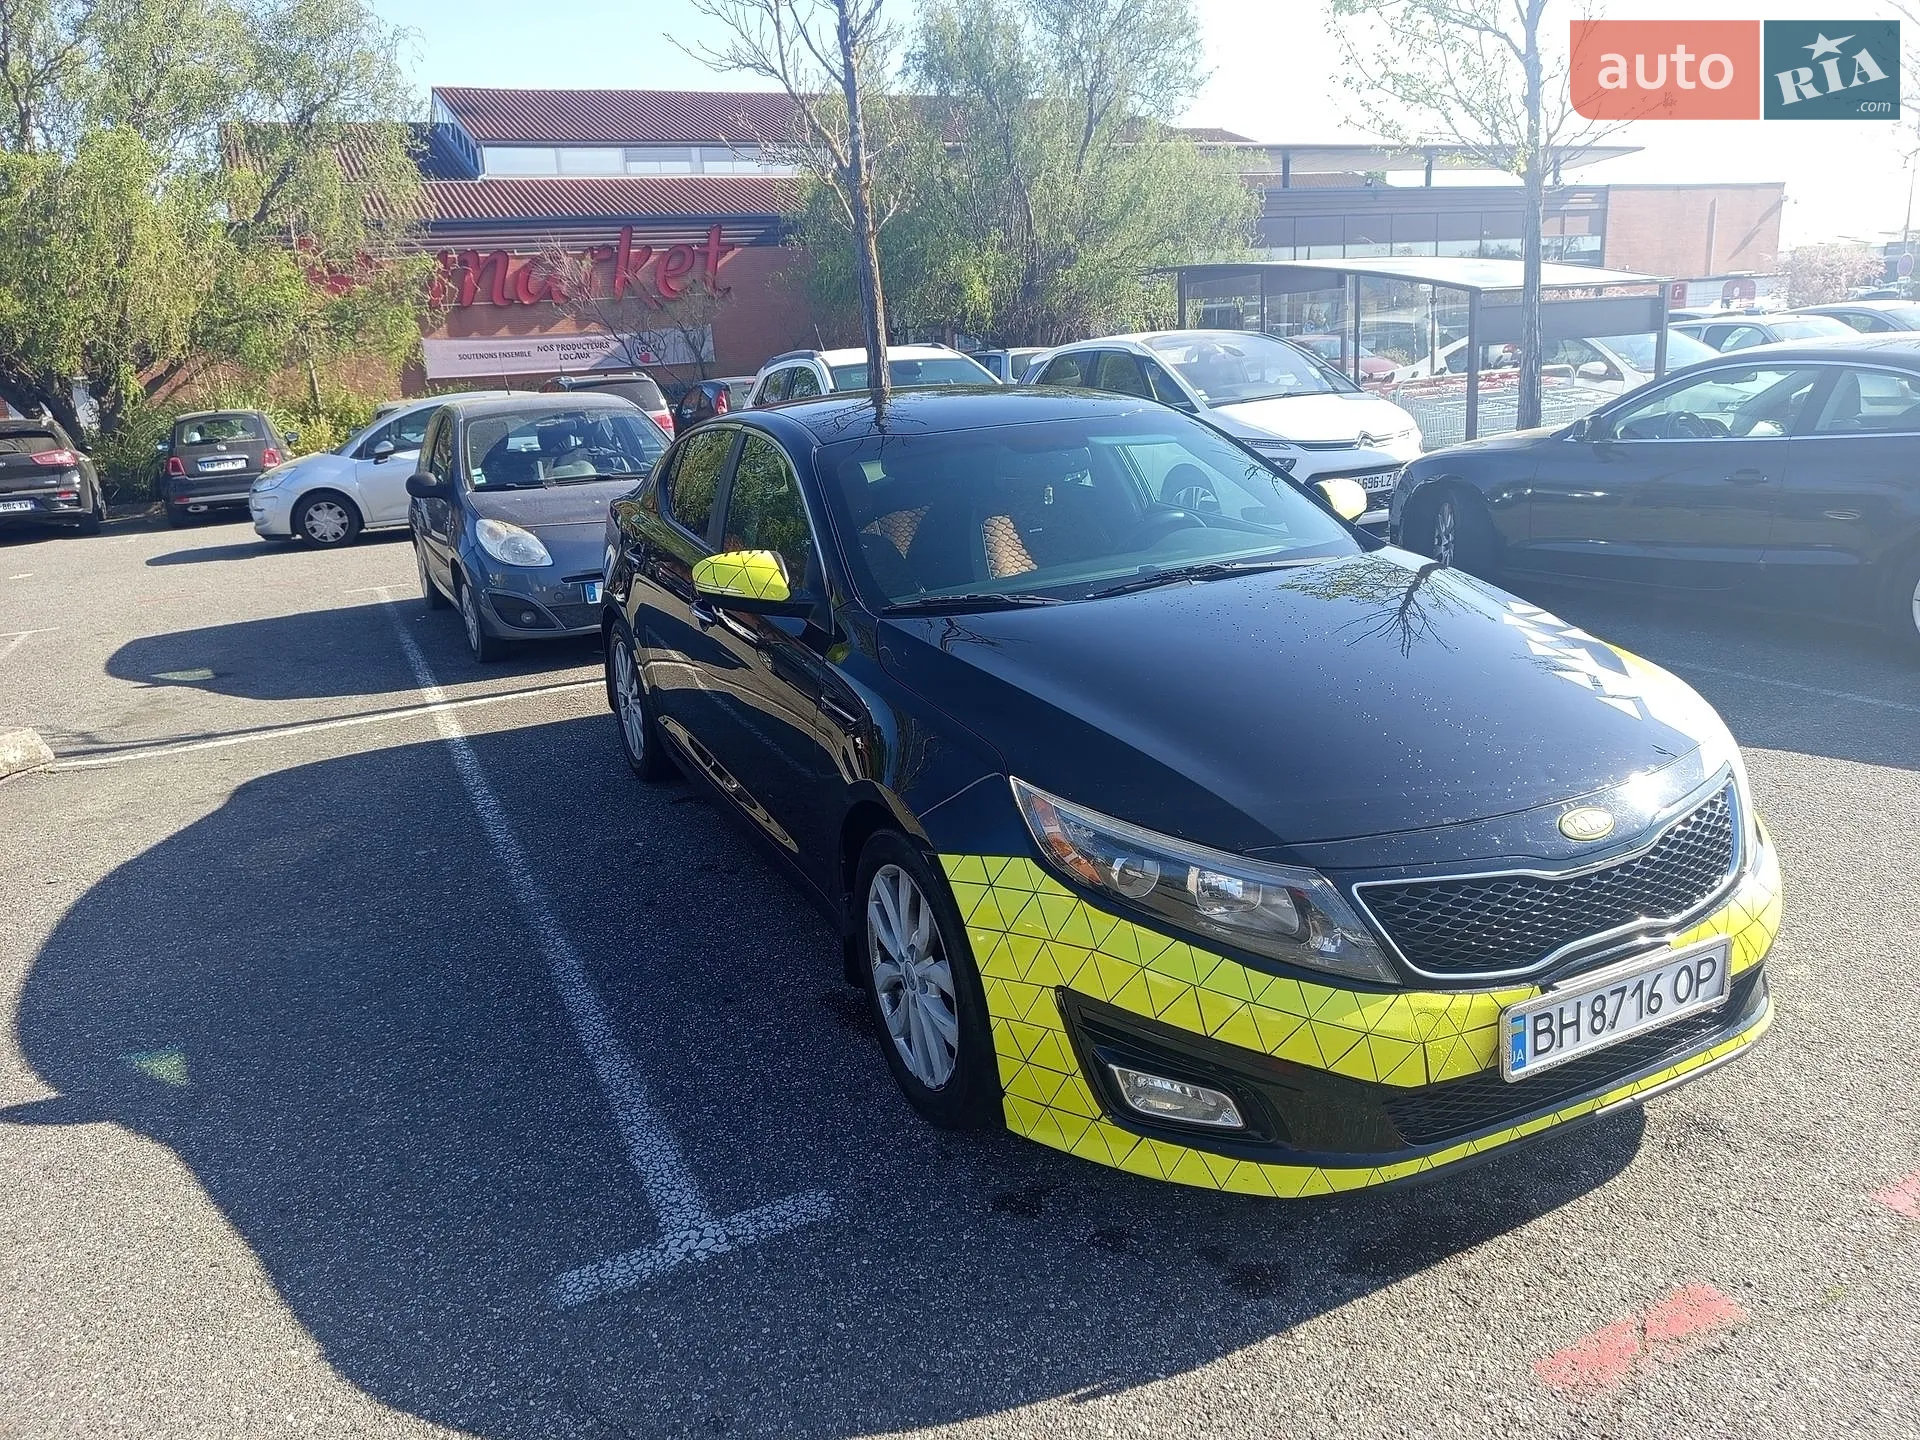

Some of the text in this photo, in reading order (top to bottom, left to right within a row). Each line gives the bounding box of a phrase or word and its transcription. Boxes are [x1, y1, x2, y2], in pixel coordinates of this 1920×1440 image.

[430, 224, 735, 309] market
[537, 341, 611, 352] NOS PRODUCTEURS
[458, 350, 533, 361] SOUTENONS ENSEMBLE
[559, 351, 591, 361] LOCAUX
[1590, 972, 1664, 1036] 8716
[1673, 957, 1717, 1004] OP
